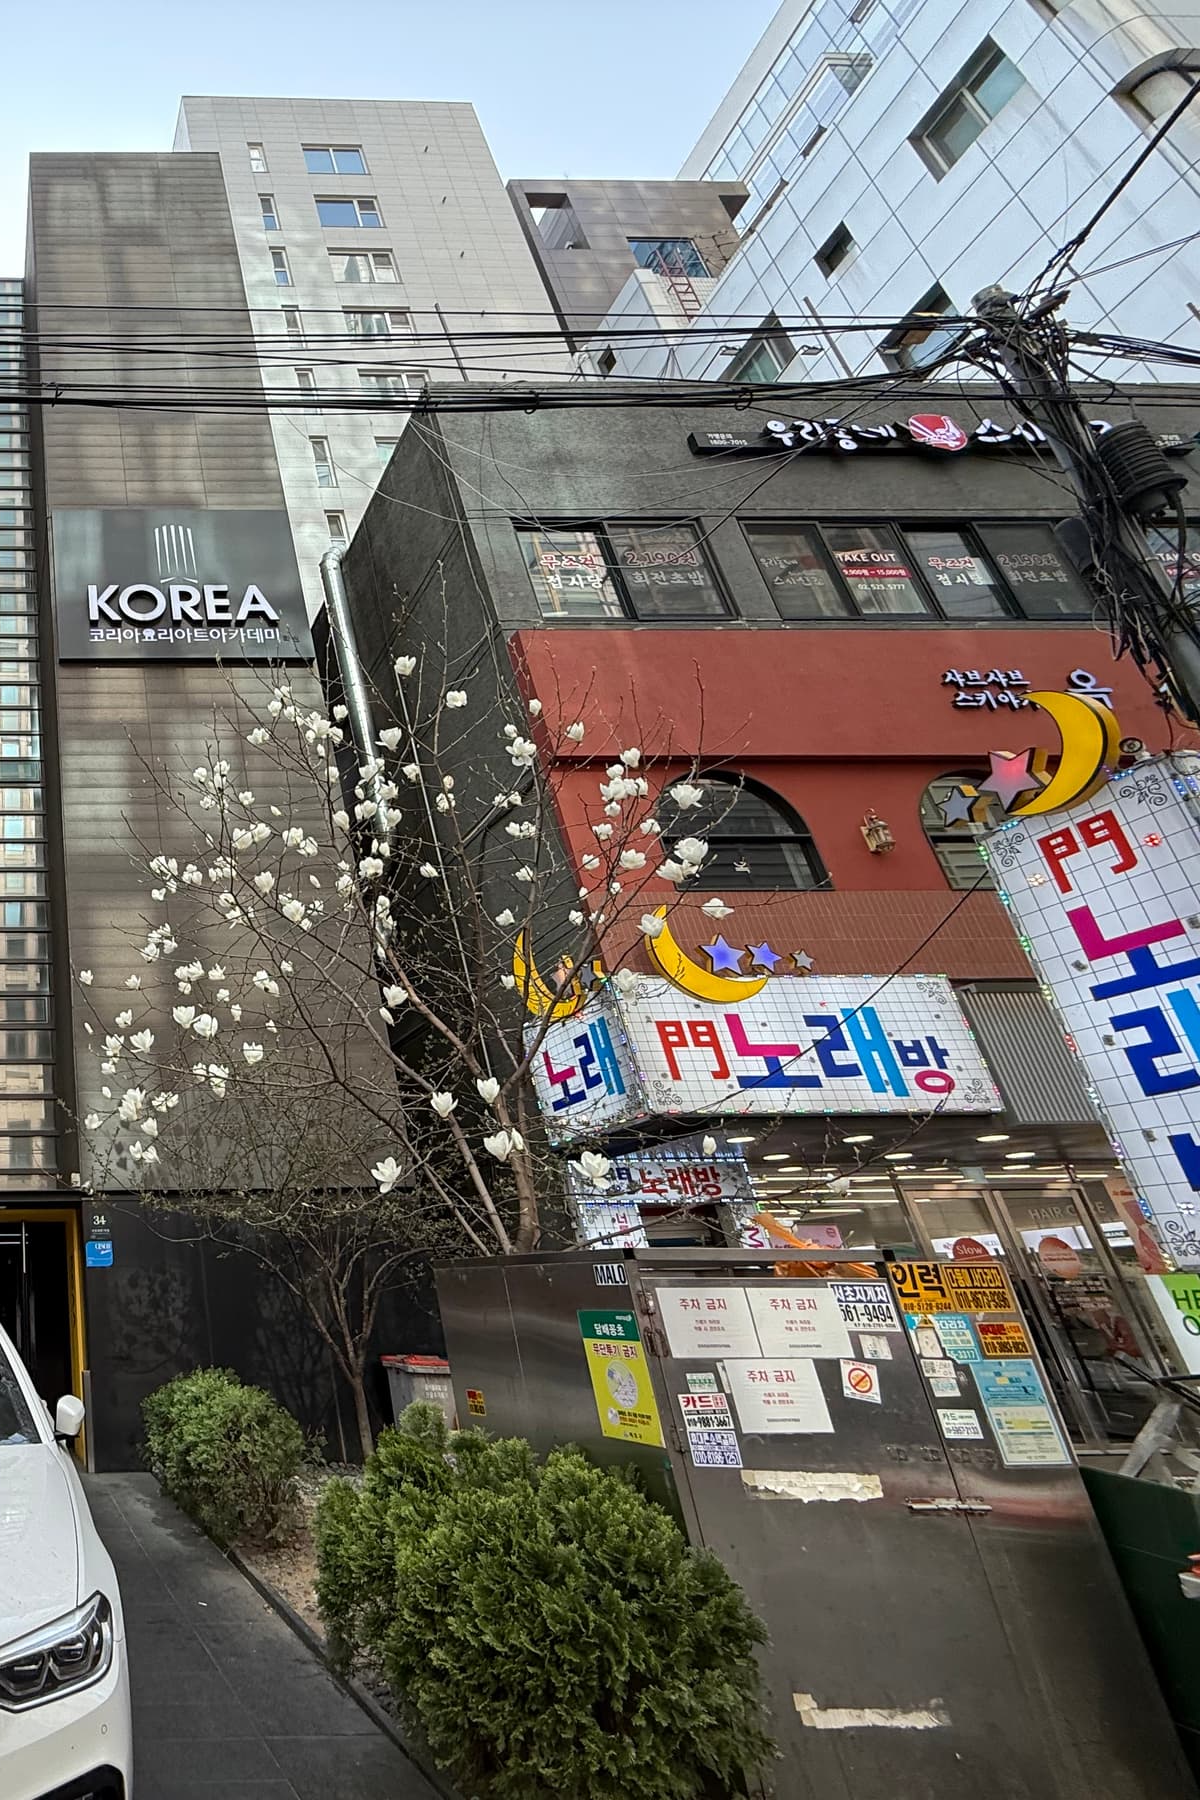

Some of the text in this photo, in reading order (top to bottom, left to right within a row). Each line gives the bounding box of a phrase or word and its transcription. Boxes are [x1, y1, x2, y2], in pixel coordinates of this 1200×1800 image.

[766, 419, 898, 451] 우리동네
[540, 554, 600, 569] 무조건
[835, 552, 897, 563] TAKE OUT
[927, 556, 978, 570] 무조건
[547, 574, 605, 589] 접시당
[632, 570, 705, 587] 회전초밥
[1006, 569, 1069, 584] 회전초밥
[87, 583, 281, 624] KOREA
[89, 627, 281, 644] 코리아요리아트아카데미
[944, 668, 1031, 687] 샤브샤브
[93, 1215, 107, 1225] 34
[1028, 1206, 1063, 1221] HAIR
[956, 1244, 983, 1255] Slow
[891, 1263, 947, 1298] 인력
[679, 1298, 728, 1311] 주차 금지
[769, 1298, 818, 1311] 주차 금지
[593, 1323, 626, 1337] 담배꽁초
[592, 1343, 638, 1359] 무단투기 금지
[747, 1370, 796, 1383] 주차 금지
[682, 1395, 714, 1409] 카드
